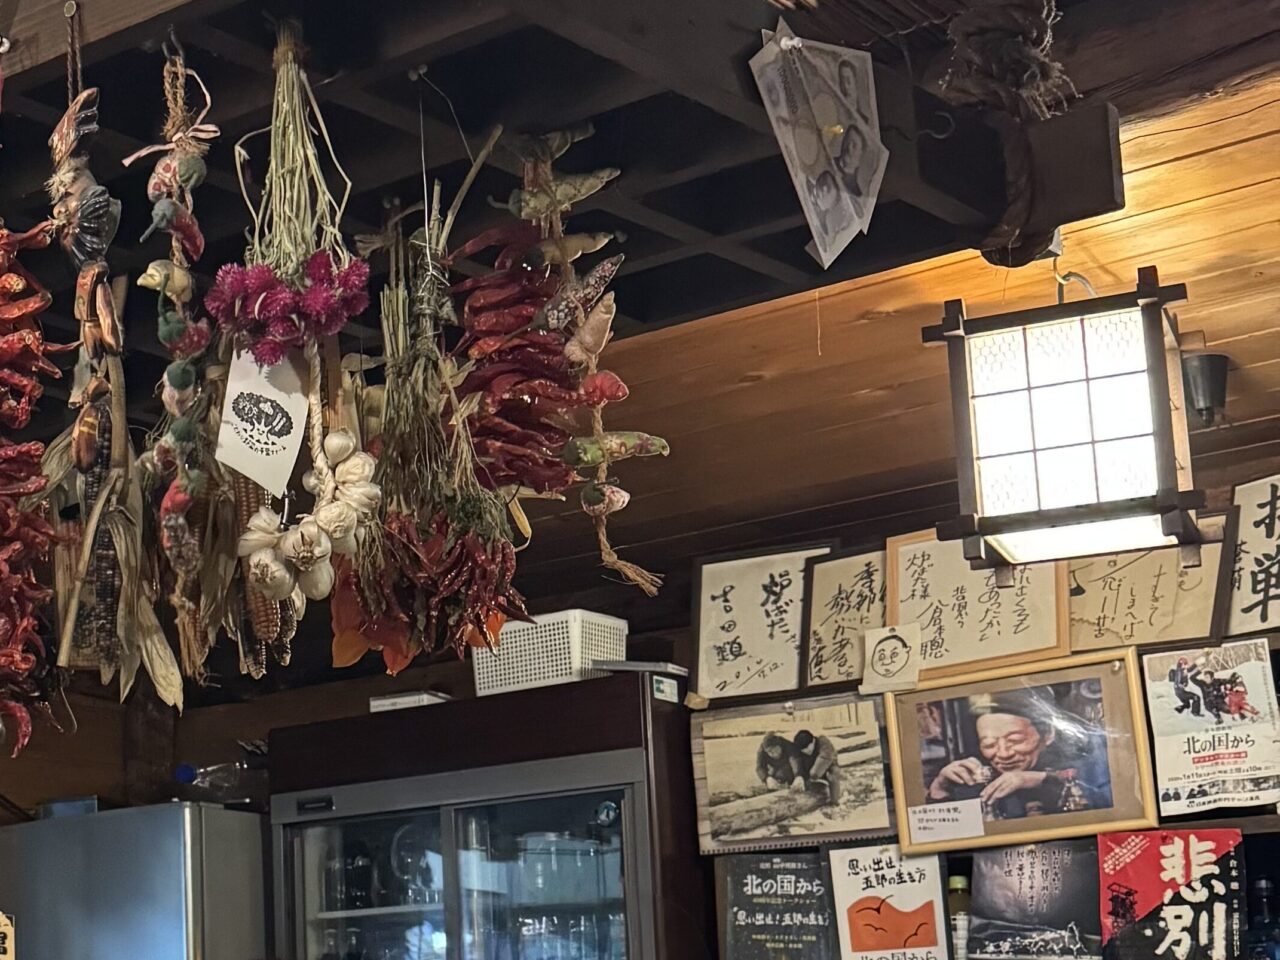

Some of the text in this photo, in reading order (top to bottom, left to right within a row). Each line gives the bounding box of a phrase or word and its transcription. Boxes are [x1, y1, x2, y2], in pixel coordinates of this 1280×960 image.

[1182, 732, 1255, 755] 北の国から
[742, 874, 826, 896] 北の国から
[861, 867, 927, 891] 五郎の生き方
